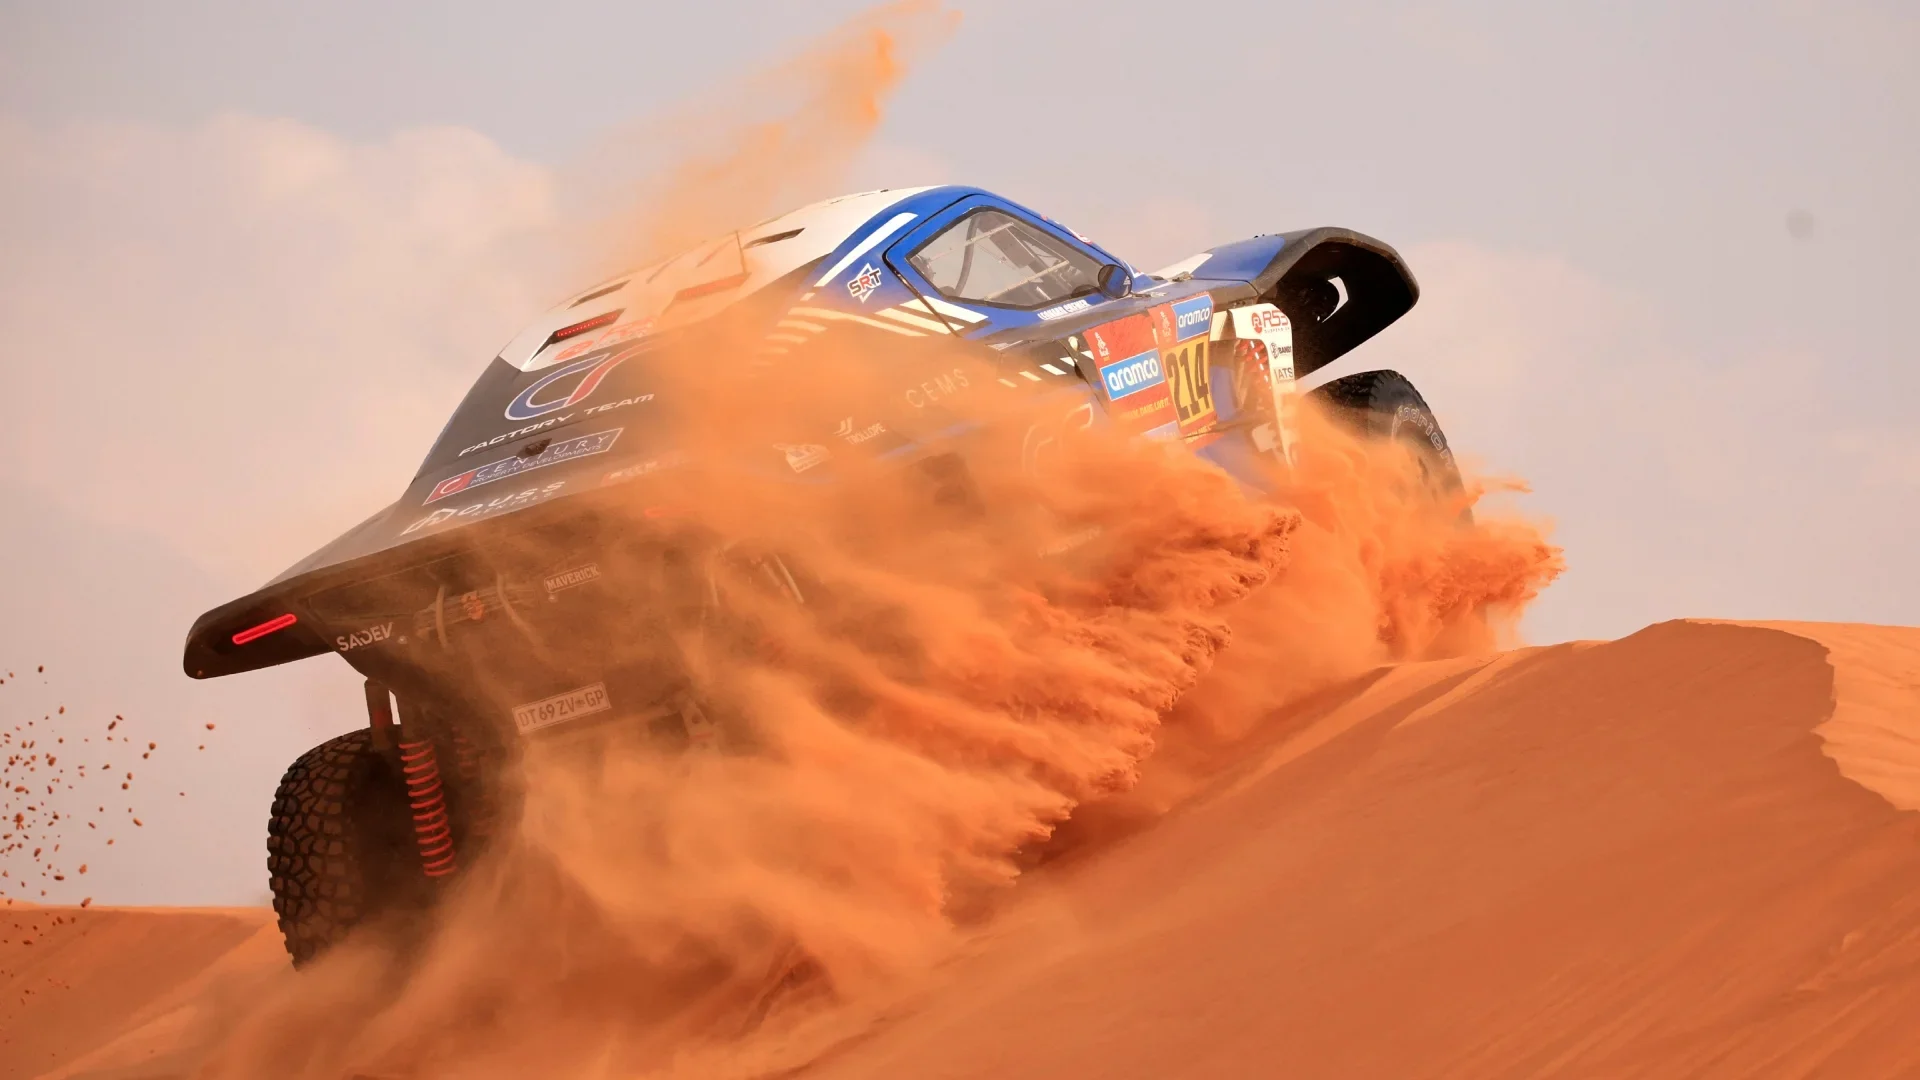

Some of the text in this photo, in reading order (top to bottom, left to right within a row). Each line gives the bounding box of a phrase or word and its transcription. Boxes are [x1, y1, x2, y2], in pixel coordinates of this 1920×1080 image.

[848, 268, 882, 298] SRT
[1178, 307, 1210, 329] aramco
[1108, 357, 1159, 392] aramco
[1164, 342, 1210, 421] 214
[1278, 367, 1294, 379] ATS
[458, 394, 655, 457] FACTORY TEAM
[470, 445, 601, 486] PROPERTY DEVELOPMENTS
[477, 434, 610, 478] CENTURY
[545, 565, 599, 591] MAVERICK
[336, 621, 394, 652] SADEV
[518, 689, 604, 727] DT 69 ZV GP
